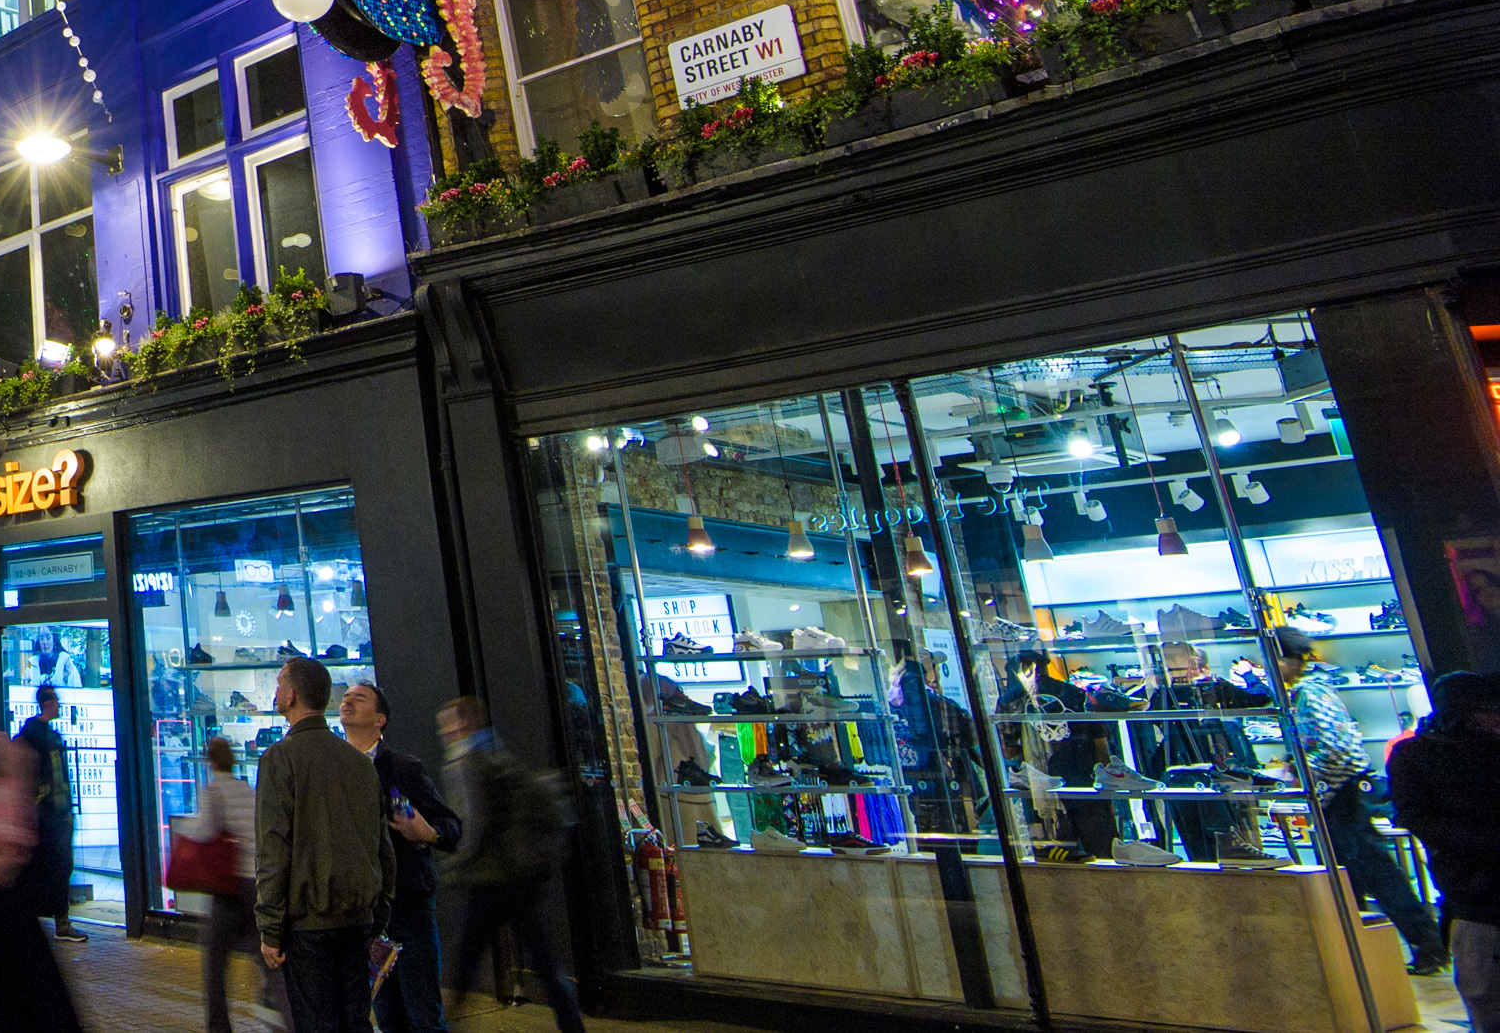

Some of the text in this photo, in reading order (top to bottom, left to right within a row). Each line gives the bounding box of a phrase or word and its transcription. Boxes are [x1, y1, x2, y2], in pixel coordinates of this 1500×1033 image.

[680, 19, 765, 63] CARNABY
[684, 37, 783, 84] STREET W1
[711, 86, 721, 97] OF
[15, 569, 36, 578] 32-34
[41, 564, 78, 576] CARNABY
[1298, 558, 1356, 583] KISS
[664, 600, 696, 615] SHOP
[650, 619, 721, 636] THE LOOK
[14, 705, 41, 716] ADIDA
